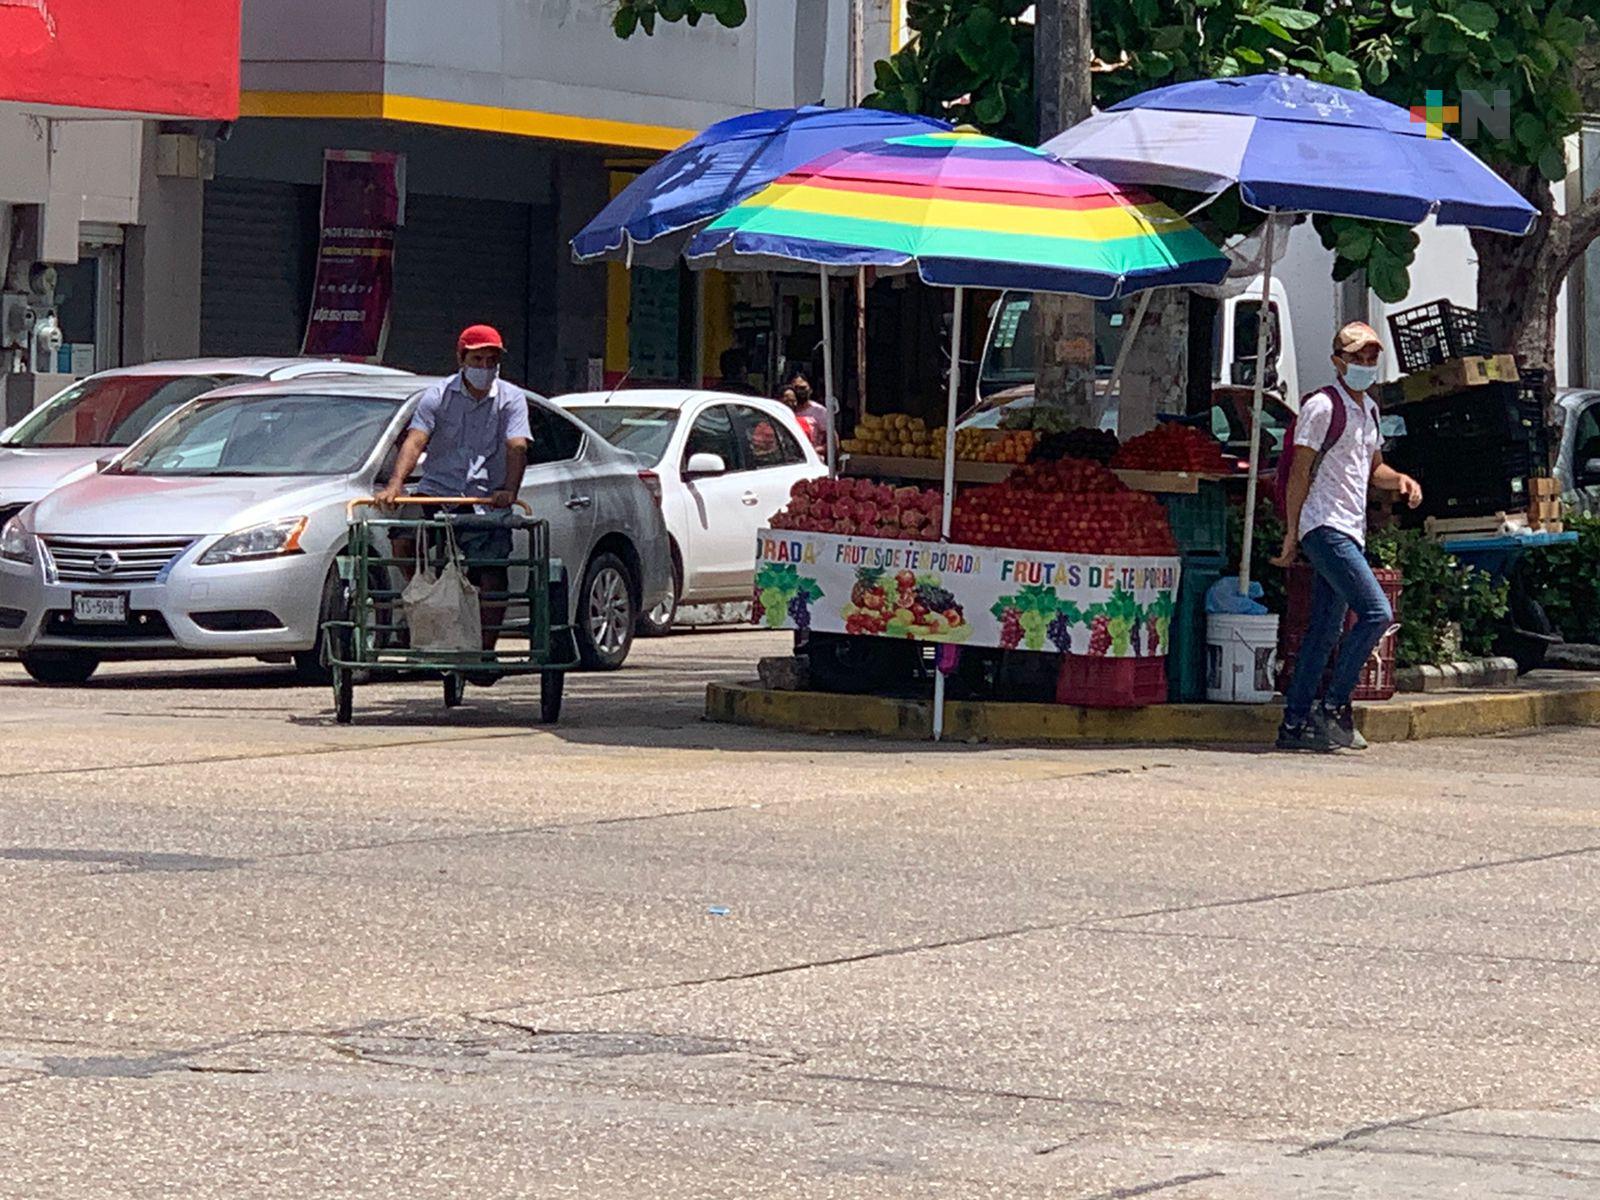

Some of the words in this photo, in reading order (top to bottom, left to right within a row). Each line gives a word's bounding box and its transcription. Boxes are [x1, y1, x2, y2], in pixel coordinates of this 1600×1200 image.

[836, 543, 883, 567] FRUTAS
[885, 549, 900, 568] DE
[904, 549, 982, 574] TEMPORADA
[1001, 560, 1082, 588] FRUTAS
[1089, 565, 1115, 589] DE
